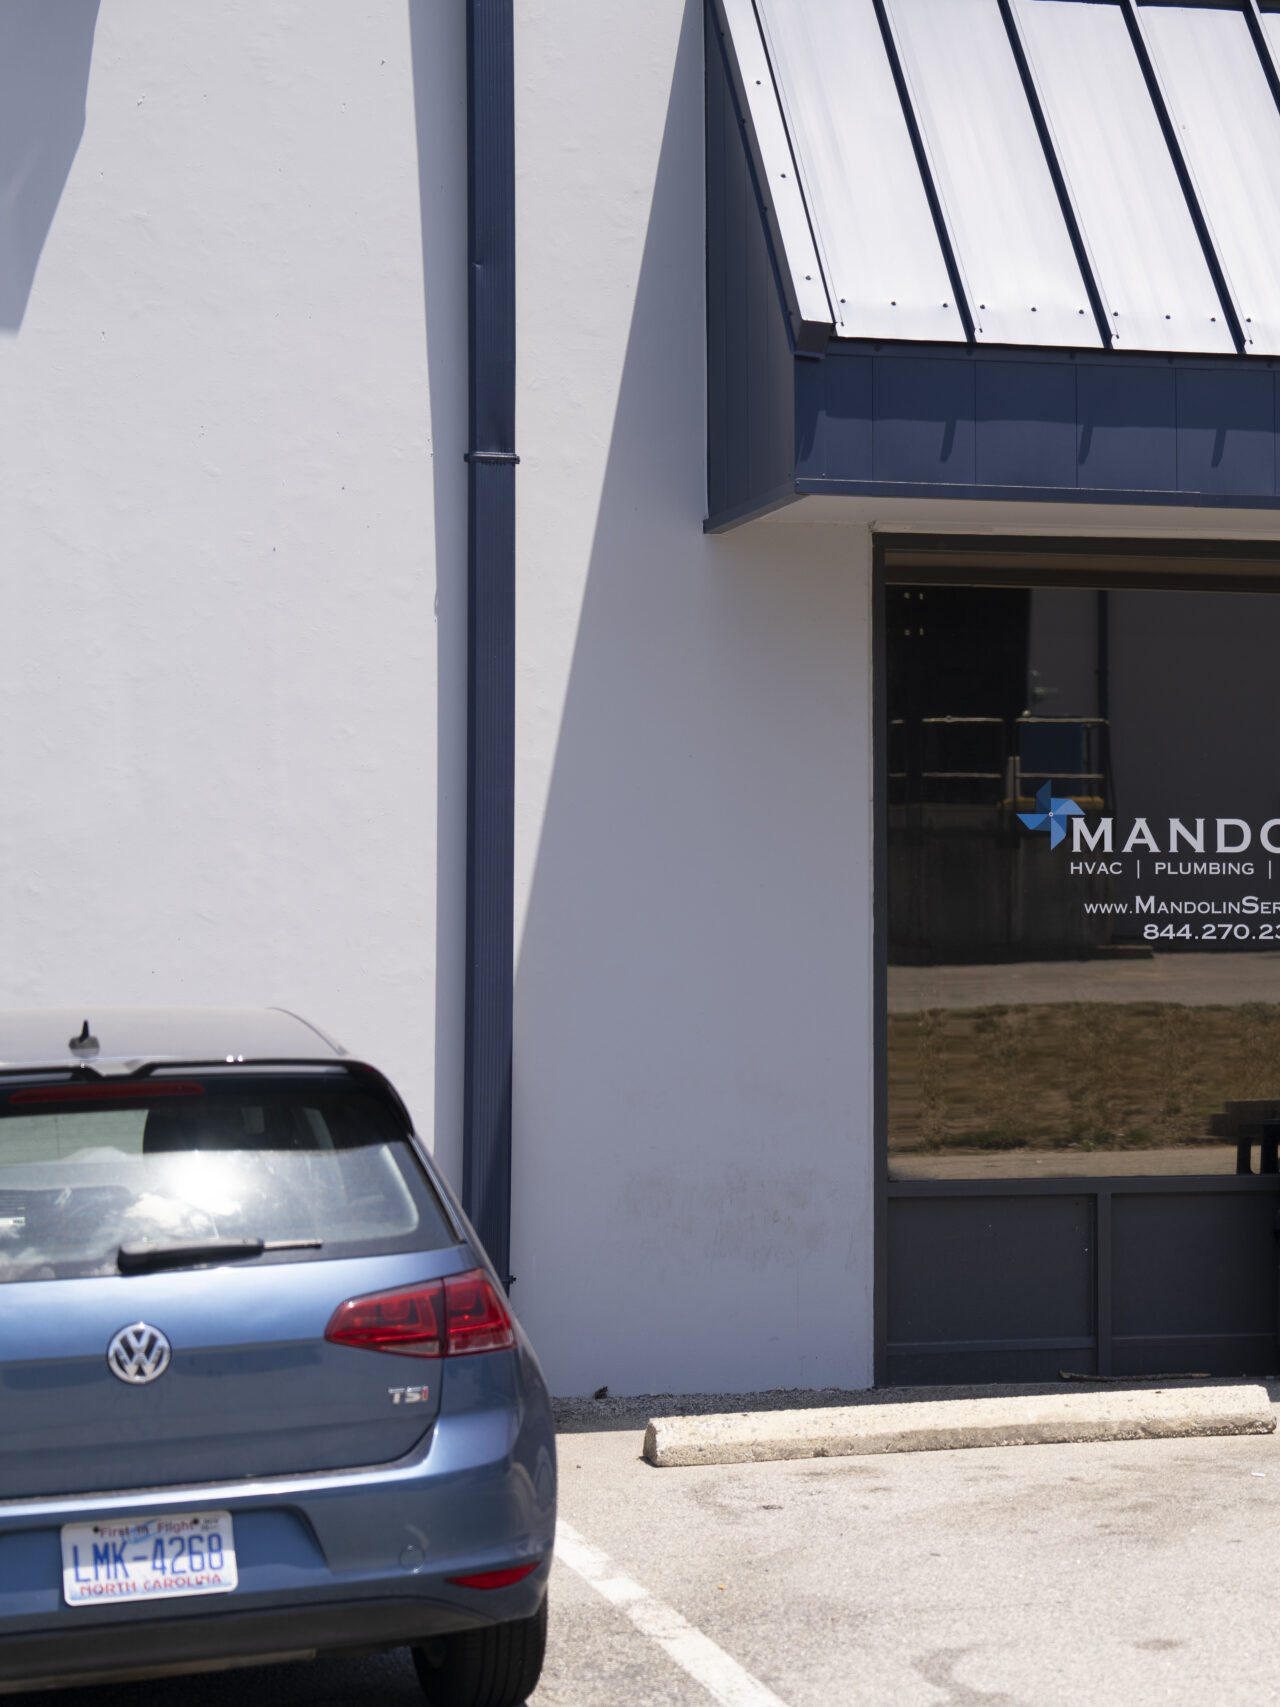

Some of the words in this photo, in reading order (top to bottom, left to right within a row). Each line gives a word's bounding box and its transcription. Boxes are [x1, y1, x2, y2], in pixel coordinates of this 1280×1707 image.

[1070, 861, 1123, 876] HVAC
[1155, 862, 1255, 876] PLUMBING
[99, 1526, 130, 1538] First
[157, 1519, 195, 1534] Flight
[72, 1532, 225, 1583] LMK-4268
[80, 1579, 137, 1597] NORTH
[143, 1573, 223, 1592] CAROLINA
